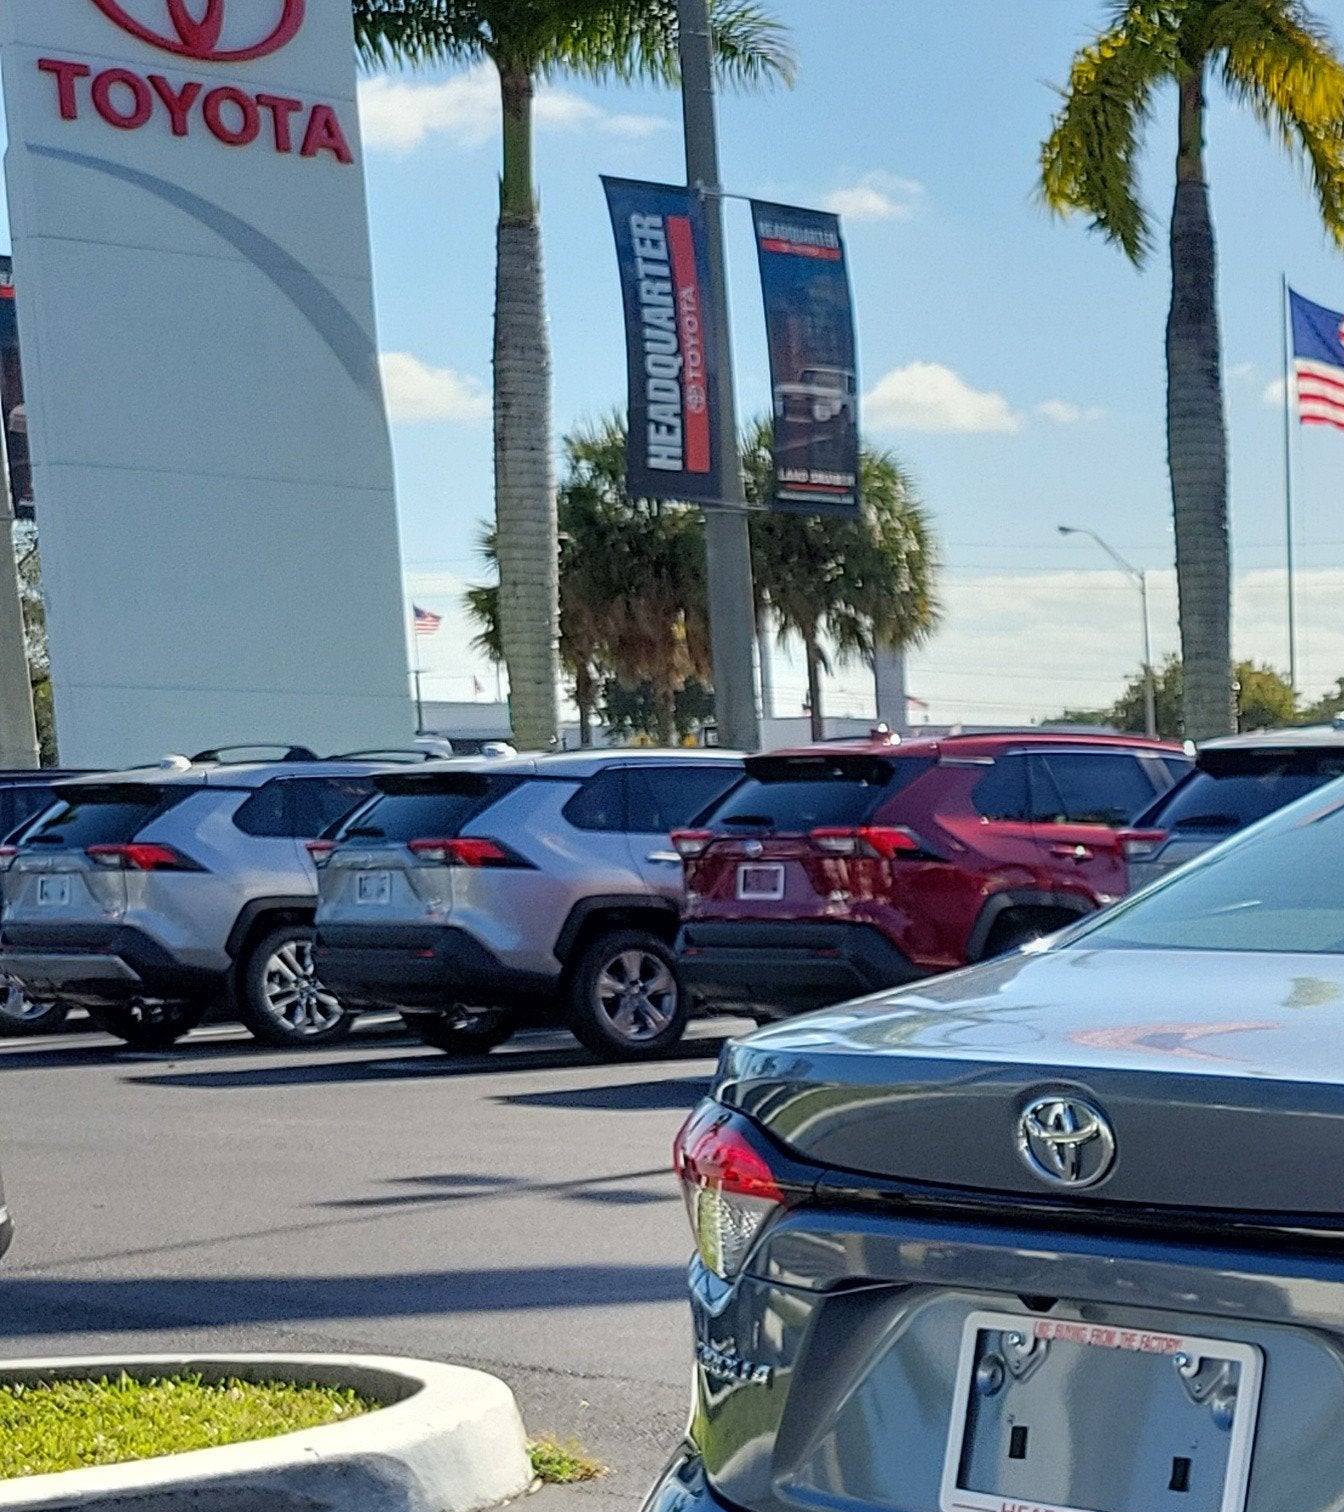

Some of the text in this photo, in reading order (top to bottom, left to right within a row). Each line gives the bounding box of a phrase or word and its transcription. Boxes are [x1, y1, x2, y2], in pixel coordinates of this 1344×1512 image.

[38, 58, 353, 165] TOYOTA
[631, 212, 683, 471] HEADQUARTER
[679, 287, 703, 378] TOYOTA
[1090, 1328, 1117, 1347] FROM
[1119, 1331, 1138, 1348] THE
